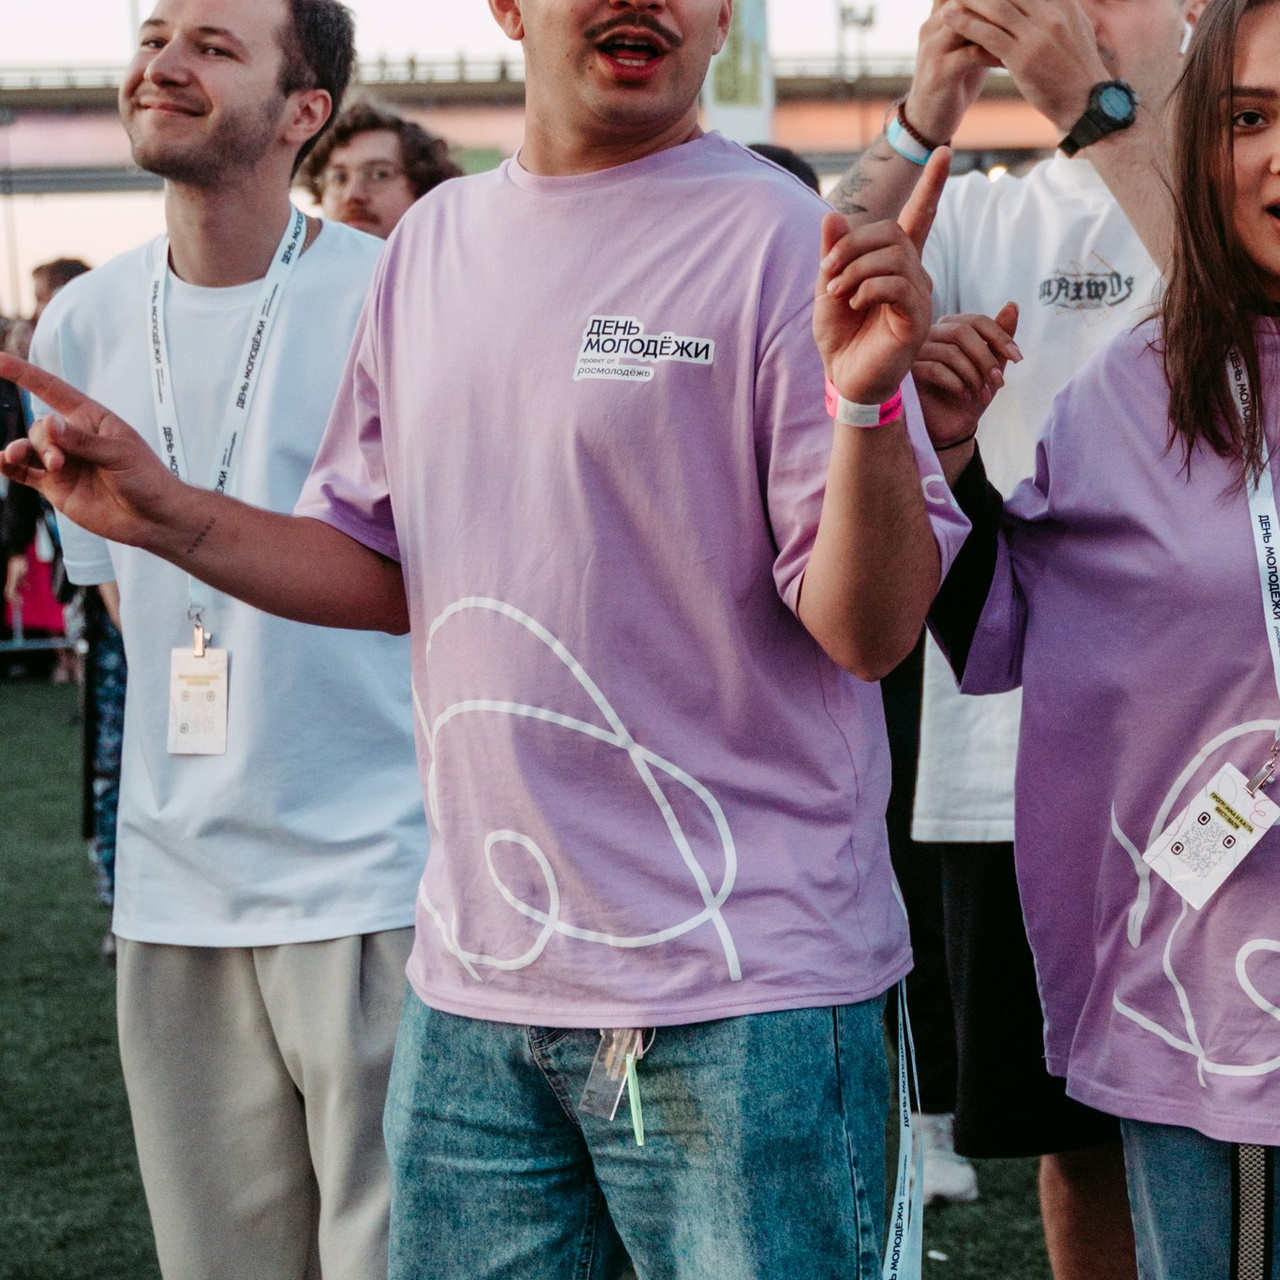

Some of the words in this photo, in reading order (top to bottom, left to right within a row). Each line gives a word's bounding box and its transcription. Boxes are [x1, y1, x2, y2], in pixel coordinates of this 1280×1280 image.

[586, 320, 640, 337] ДЕНЬ
[583, 336, 710, 360] МОЛОДЁЖИ
[236, 382, 249, 409] ДЕНЬ
[244, 320, 266, 380] МОЛОДЁЖИ
[577, 367, 650, 377] росмолодёжь
[1259, 514, 1272, 544] ДЕНЬ
[890, 1202, 904, 1271] МОЛОДЁЖИ
